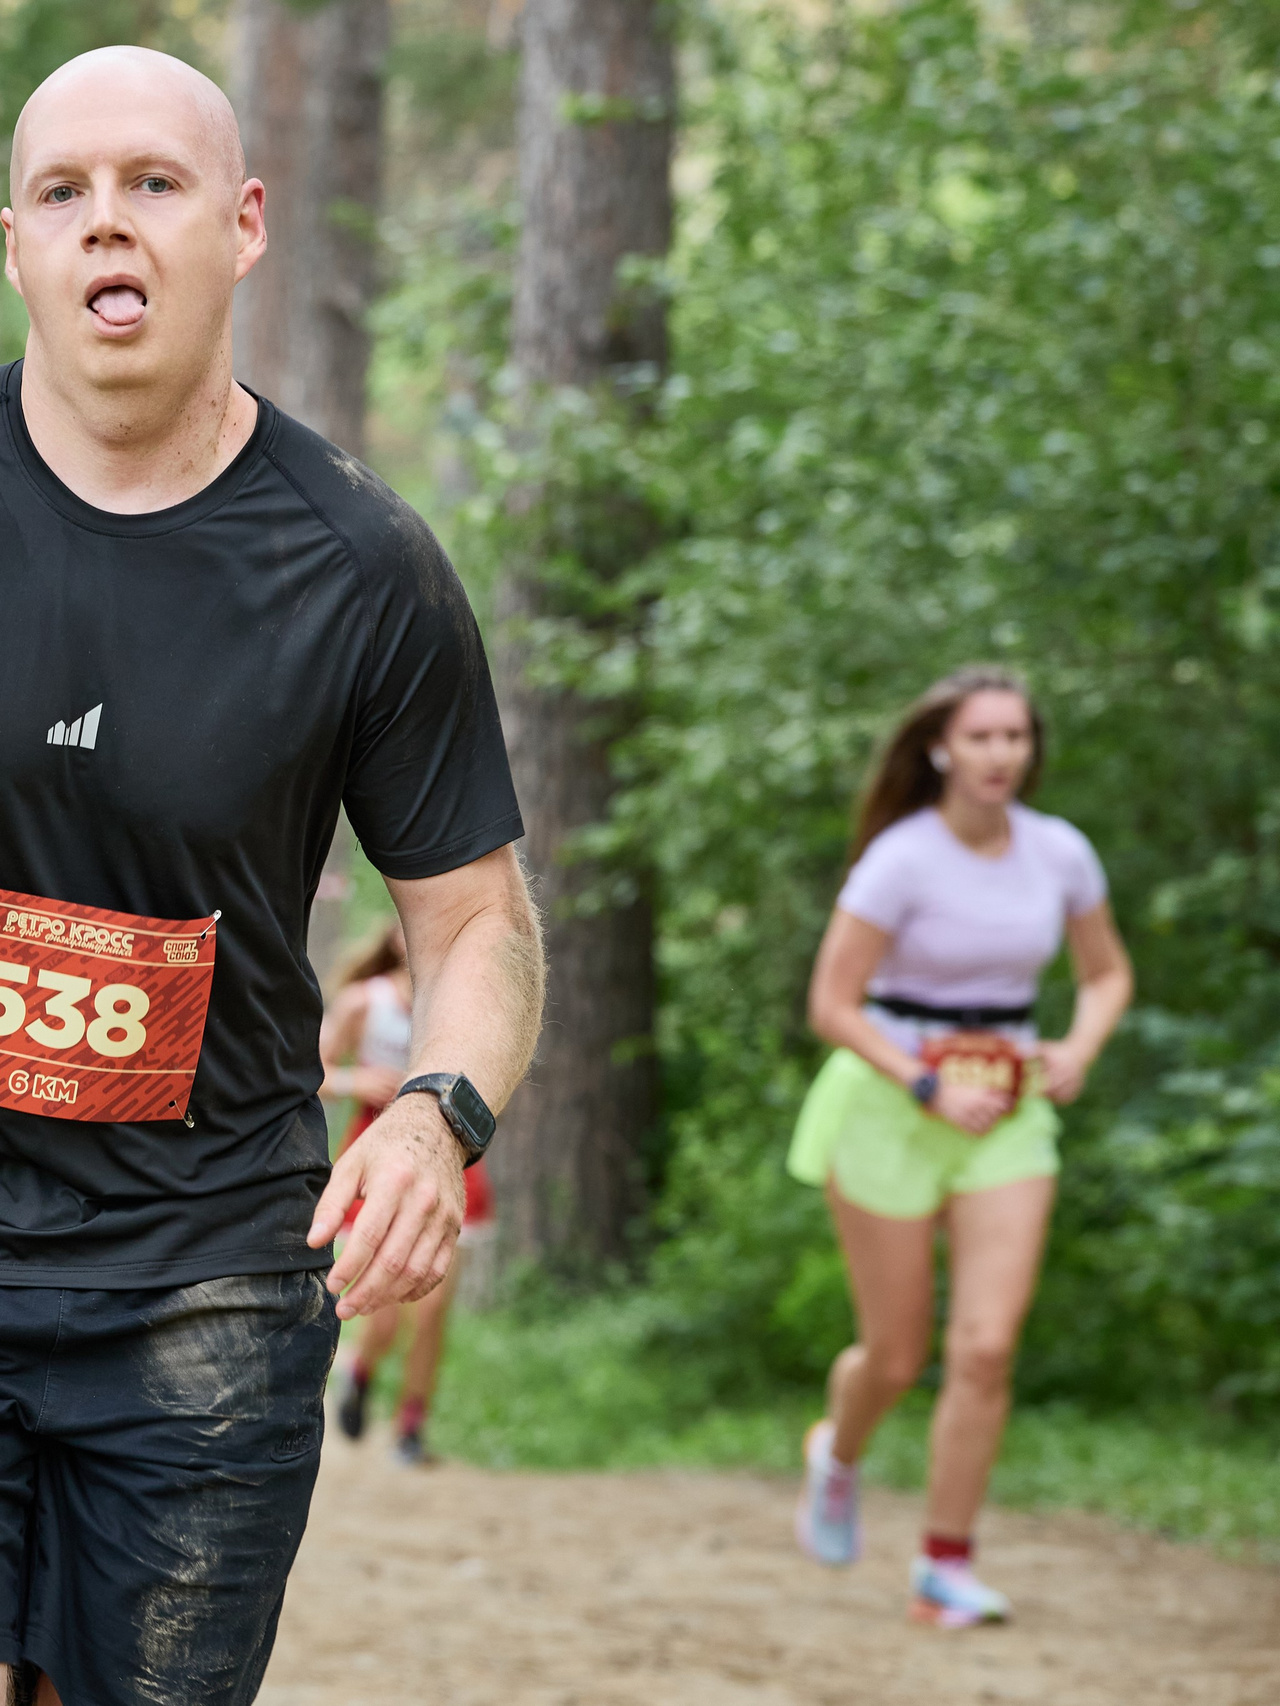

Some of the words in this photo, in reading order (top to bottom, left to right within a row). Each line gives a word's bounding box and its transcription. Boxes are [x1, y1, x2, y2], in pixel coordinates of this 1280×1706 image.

[2, 925, 16, 933] ко
[6, 910, 66, 936] РЕТРО
[69, 922, 135, 950] КРОСС
[165, 942, 195, 951] СПОРТ
[169, 951, 197, 960] СОЮЗ
[8, 1069, 30, 1095] 6
